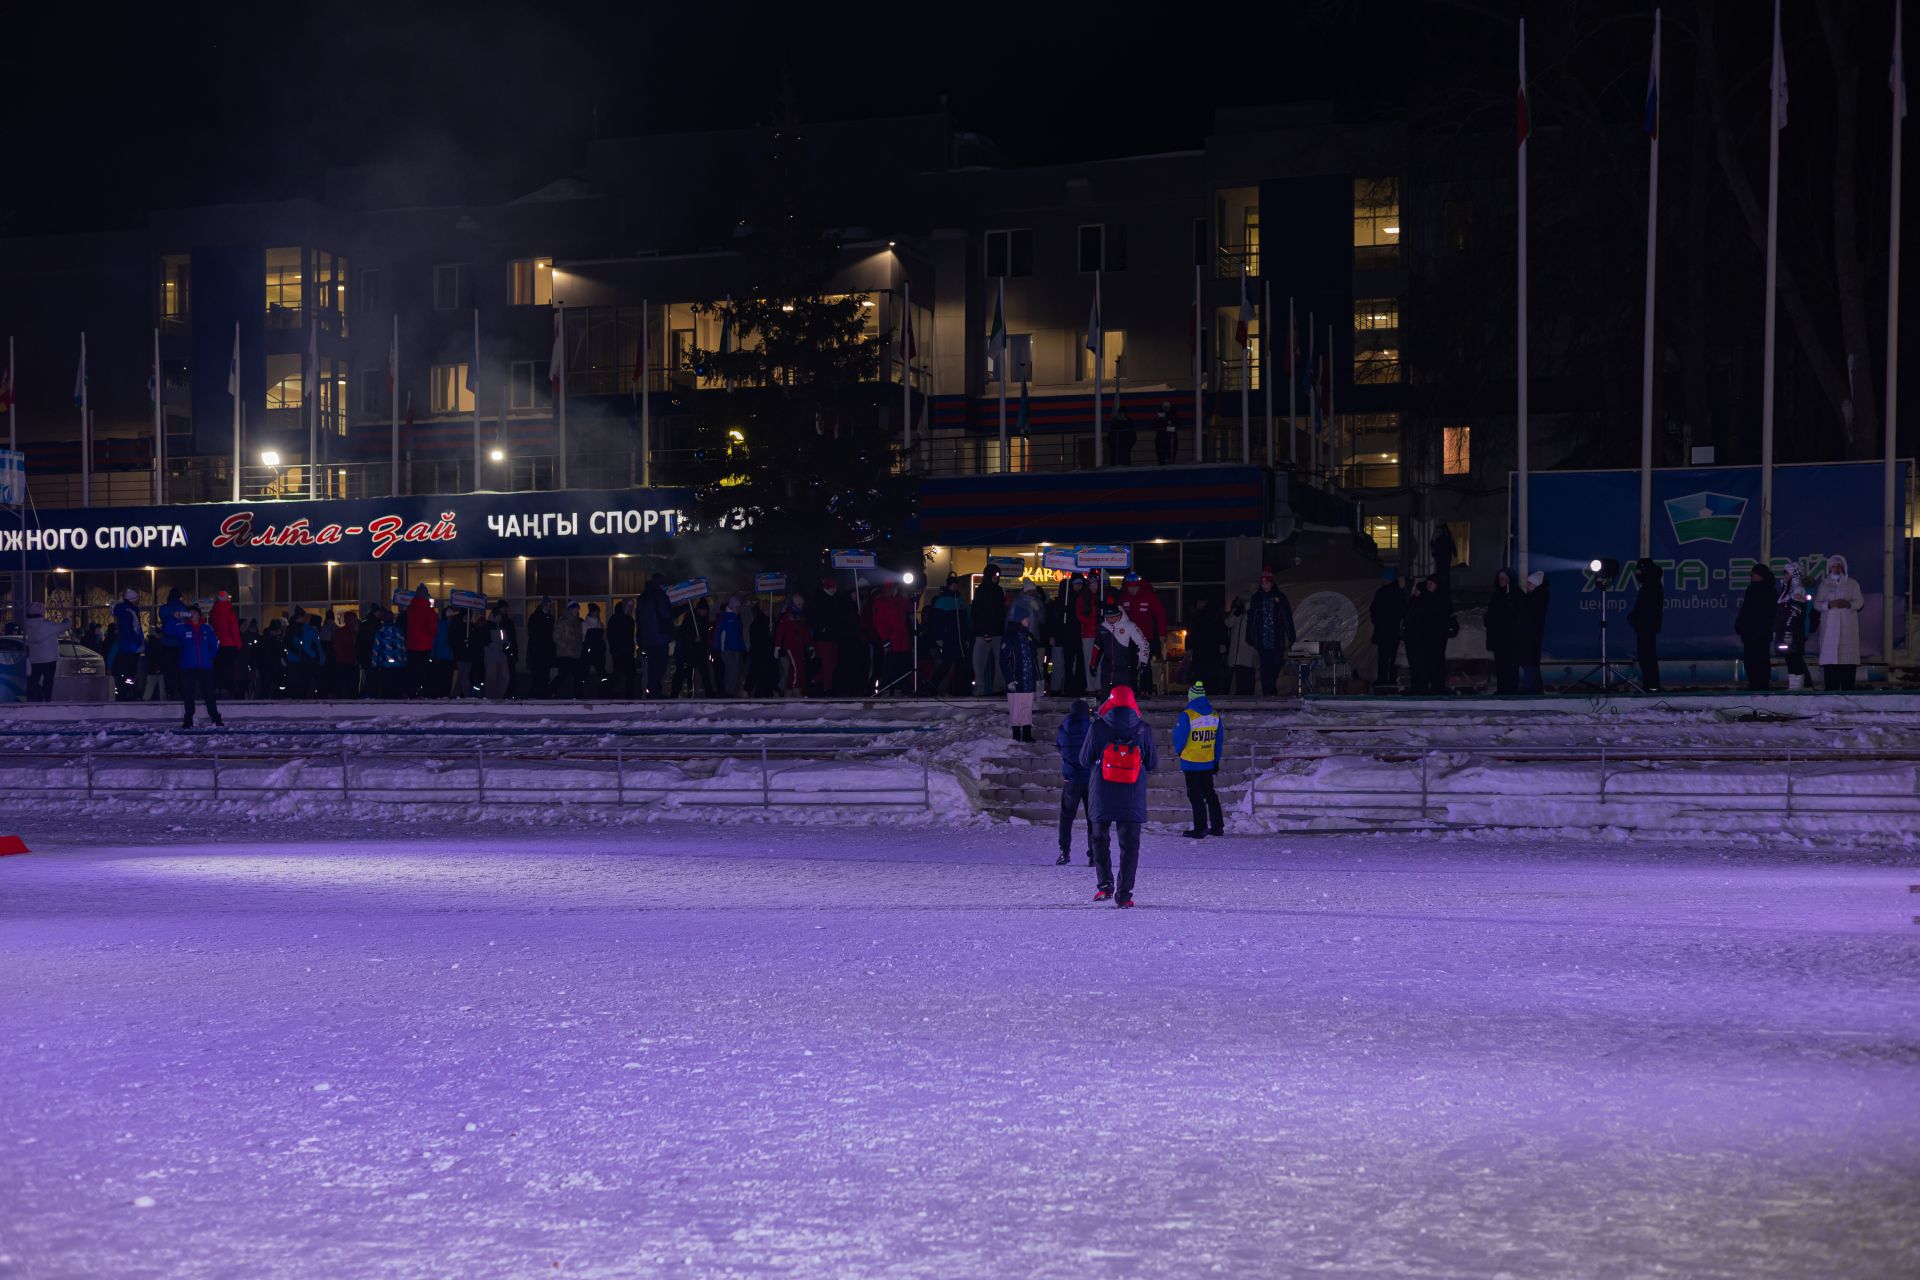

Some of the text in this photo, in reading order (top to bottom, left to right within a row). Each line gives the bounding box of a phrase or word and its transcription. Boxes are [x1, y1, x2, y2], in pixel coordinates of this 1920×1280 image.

[0, 525, 187, 551] ЖНОГО СПОРТА
[212, 511, 457, 558] Ялта-Зай
[487, 512, 578, 540] ЧАҢГЫ
[1192, 730, 1217, 742] СУДЬ
